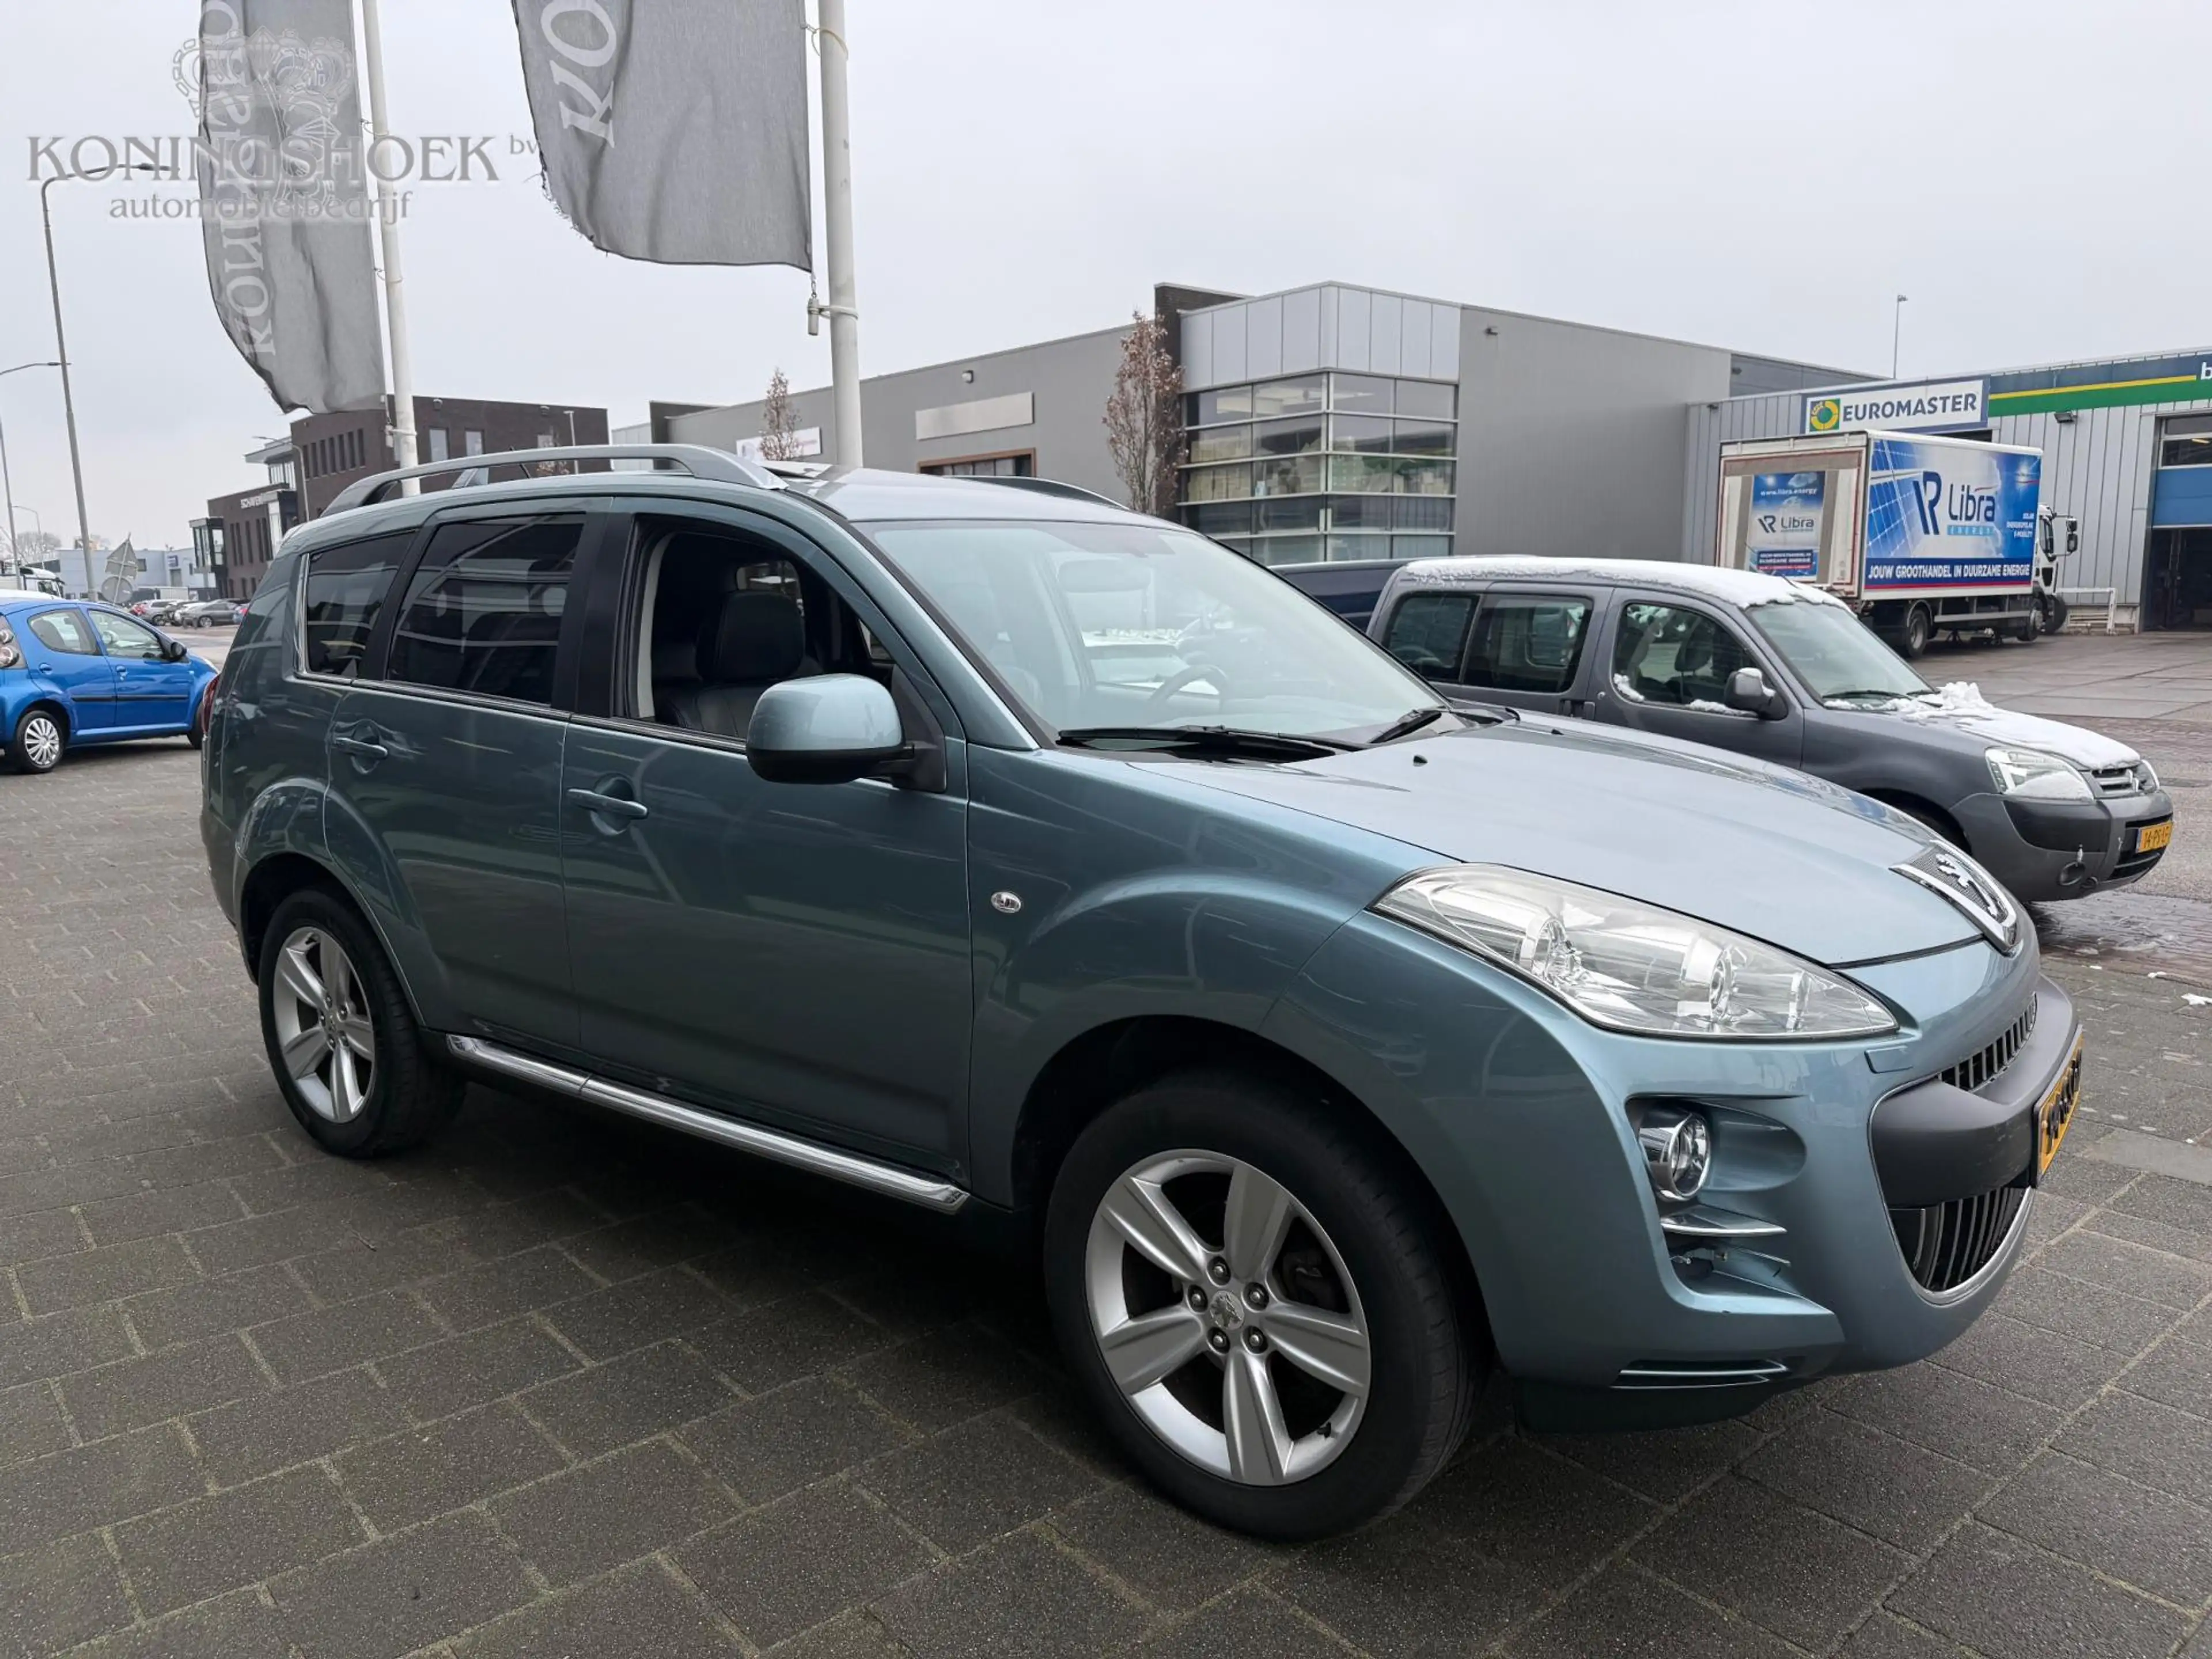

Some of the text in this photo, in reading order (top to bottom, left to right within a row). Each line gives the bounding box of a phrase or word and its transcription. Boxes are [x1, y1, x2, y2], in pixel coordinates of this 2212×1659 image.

[1843, 393, 1977, 422] EUROMASTER
[1948, 483, 1995, 521] Libra
[1781, 517, 1814, 529] Libra
[1868, 564, 2030, 579] JOUW GROOTHANDEL IN DUURZAME ENERGIE
